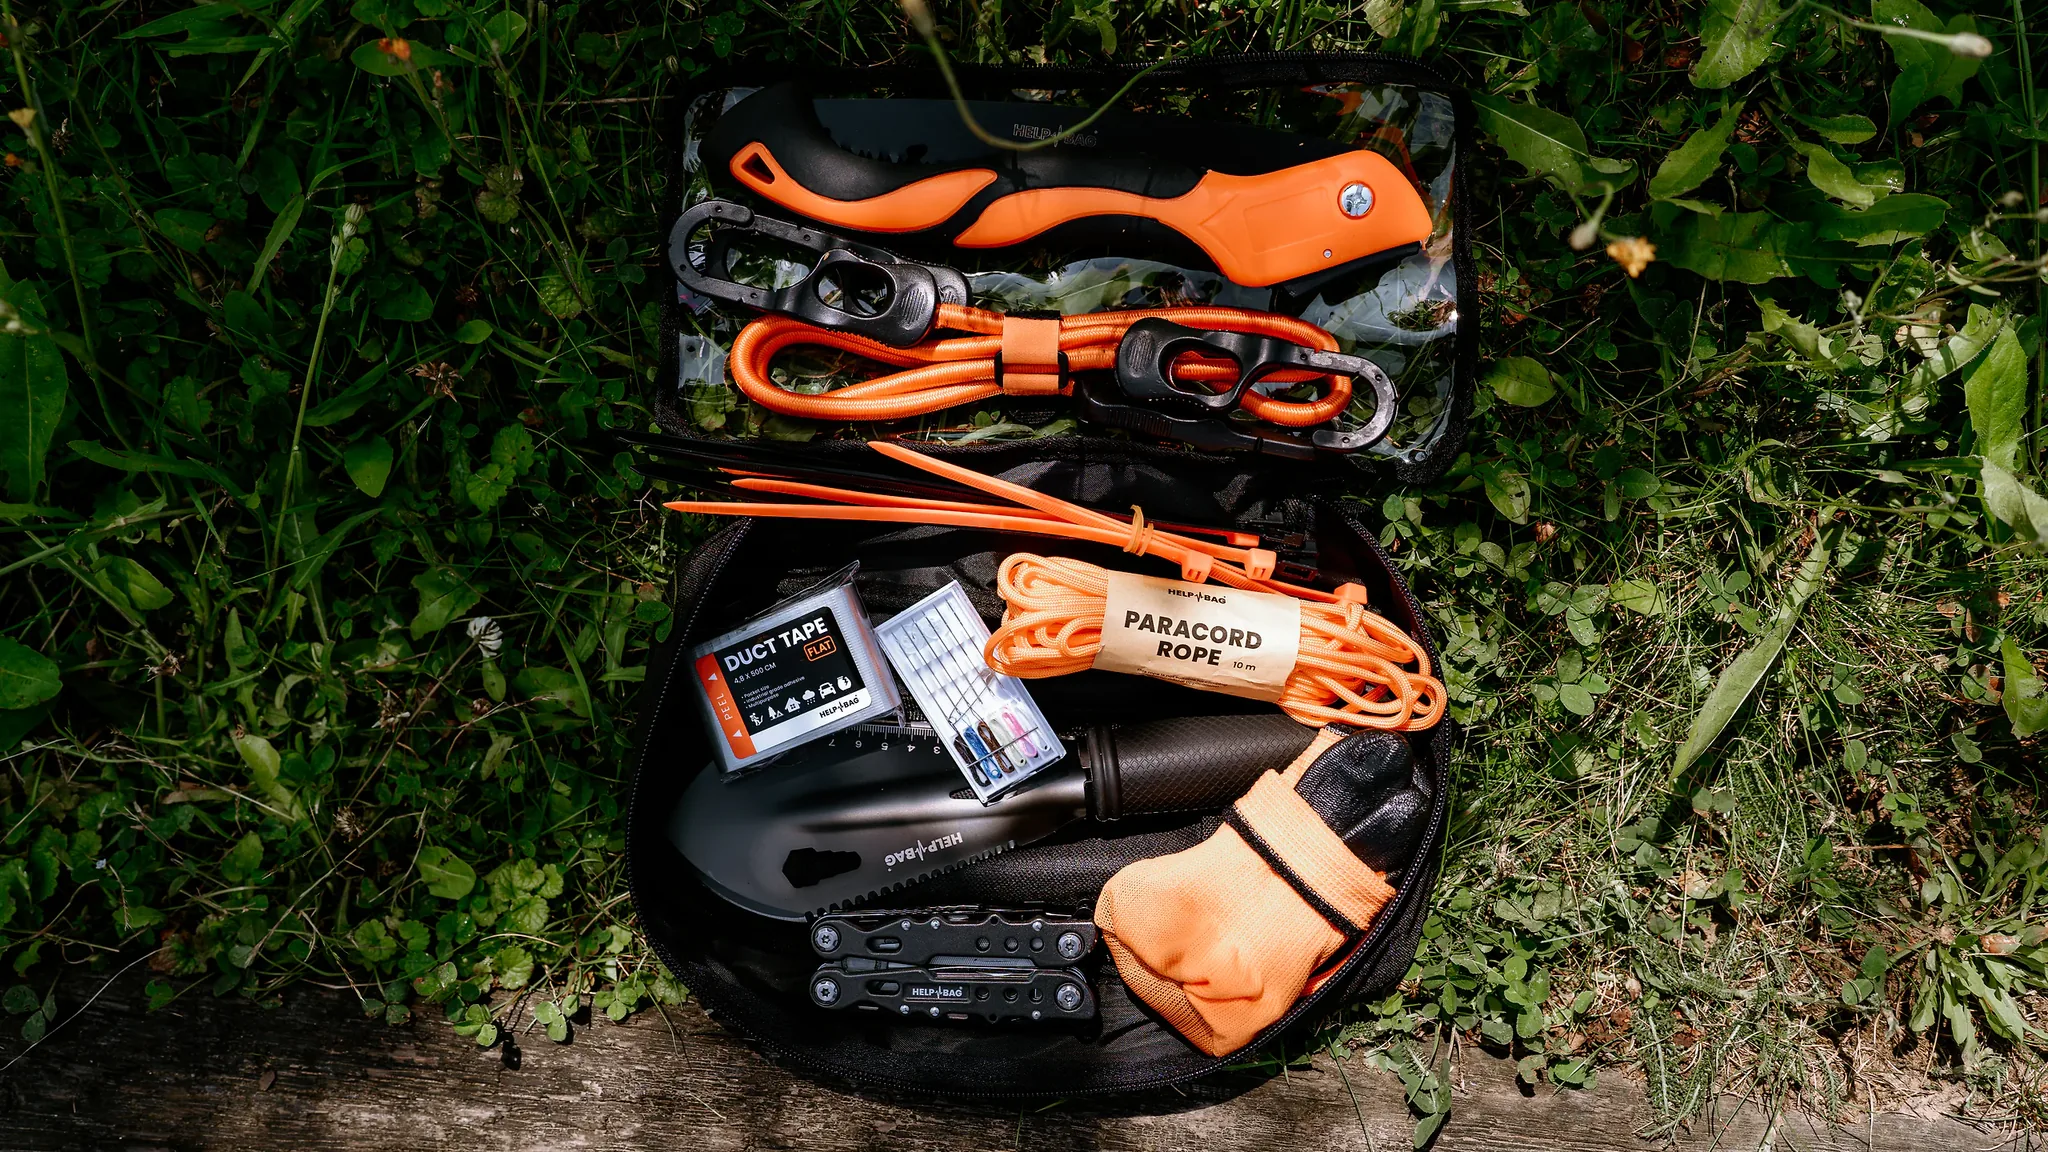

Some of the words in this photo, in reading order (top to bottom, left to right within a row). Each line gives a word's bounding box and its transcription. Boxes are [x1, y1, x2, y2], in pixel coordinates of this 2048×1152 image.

[1013, 123, 1051, 140] HELP
[1168, 588, 1194, 598] HELP
[1204, 594, 1227, 604] BAG
[1124, 610, 1262, 650] PARACORD
[724, 638, 777, 672] DUCT
[778, 617, 828, 649] TAPE
[807, 640, 832, 657] FLAT
[1156, 640, 1222, 666] ROPE
[750, 667, 765, 677] 500
[764, 662, 777, 672] CM
[1233, 661, 1243, 669] 10
[1245, 663, 1256, 671] m
[783, 676, 806, 688] adhesive
[743, 688, 760, 698] Pocket
[716, 693, 733, 721] PEEL
[819, 706, 838, 719] HELP
[843, 697, 859, 709] BAG
[828, 739, 836, 747] 7
[855, 740, 862, 748] 6
[881, 742, 889, 751] 5
[907, 744, 916, 752] 4
[933, 746, 941, 755] 3
[928, 832, 963, 853] HELP
[884, 847, 916, 866] BAG
[912, 988, 935, 996] HELP
[942, 989, 963, 997] BAG
